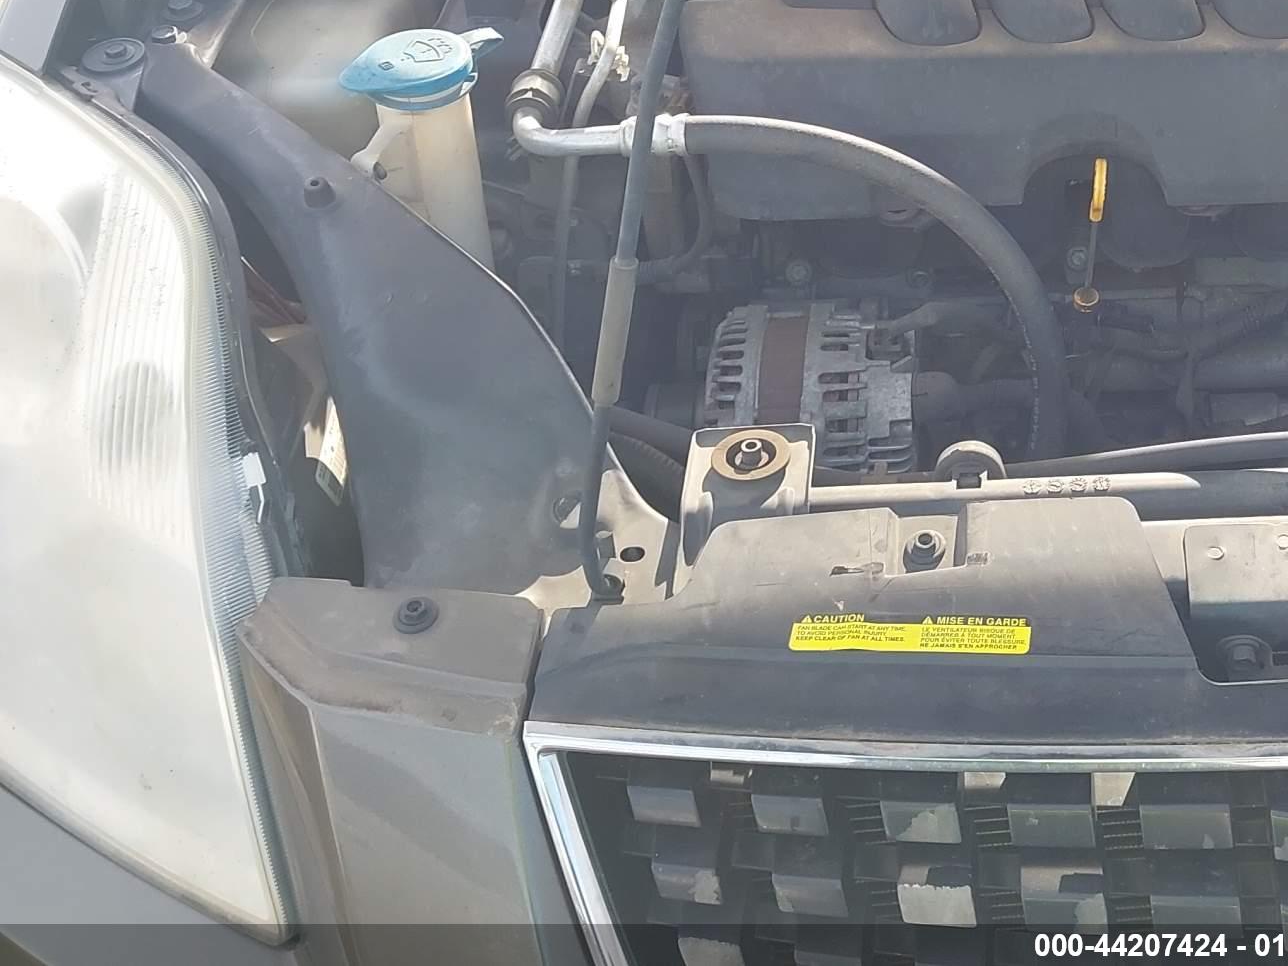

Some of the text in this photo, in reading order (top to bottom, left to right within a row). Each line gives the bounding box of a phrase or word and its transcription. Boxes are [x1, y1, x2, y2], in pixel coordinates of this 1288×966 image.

[813, 614, 865, 623] CAUTION
[936, 616, 1027, 626] MISE EN GARDE
